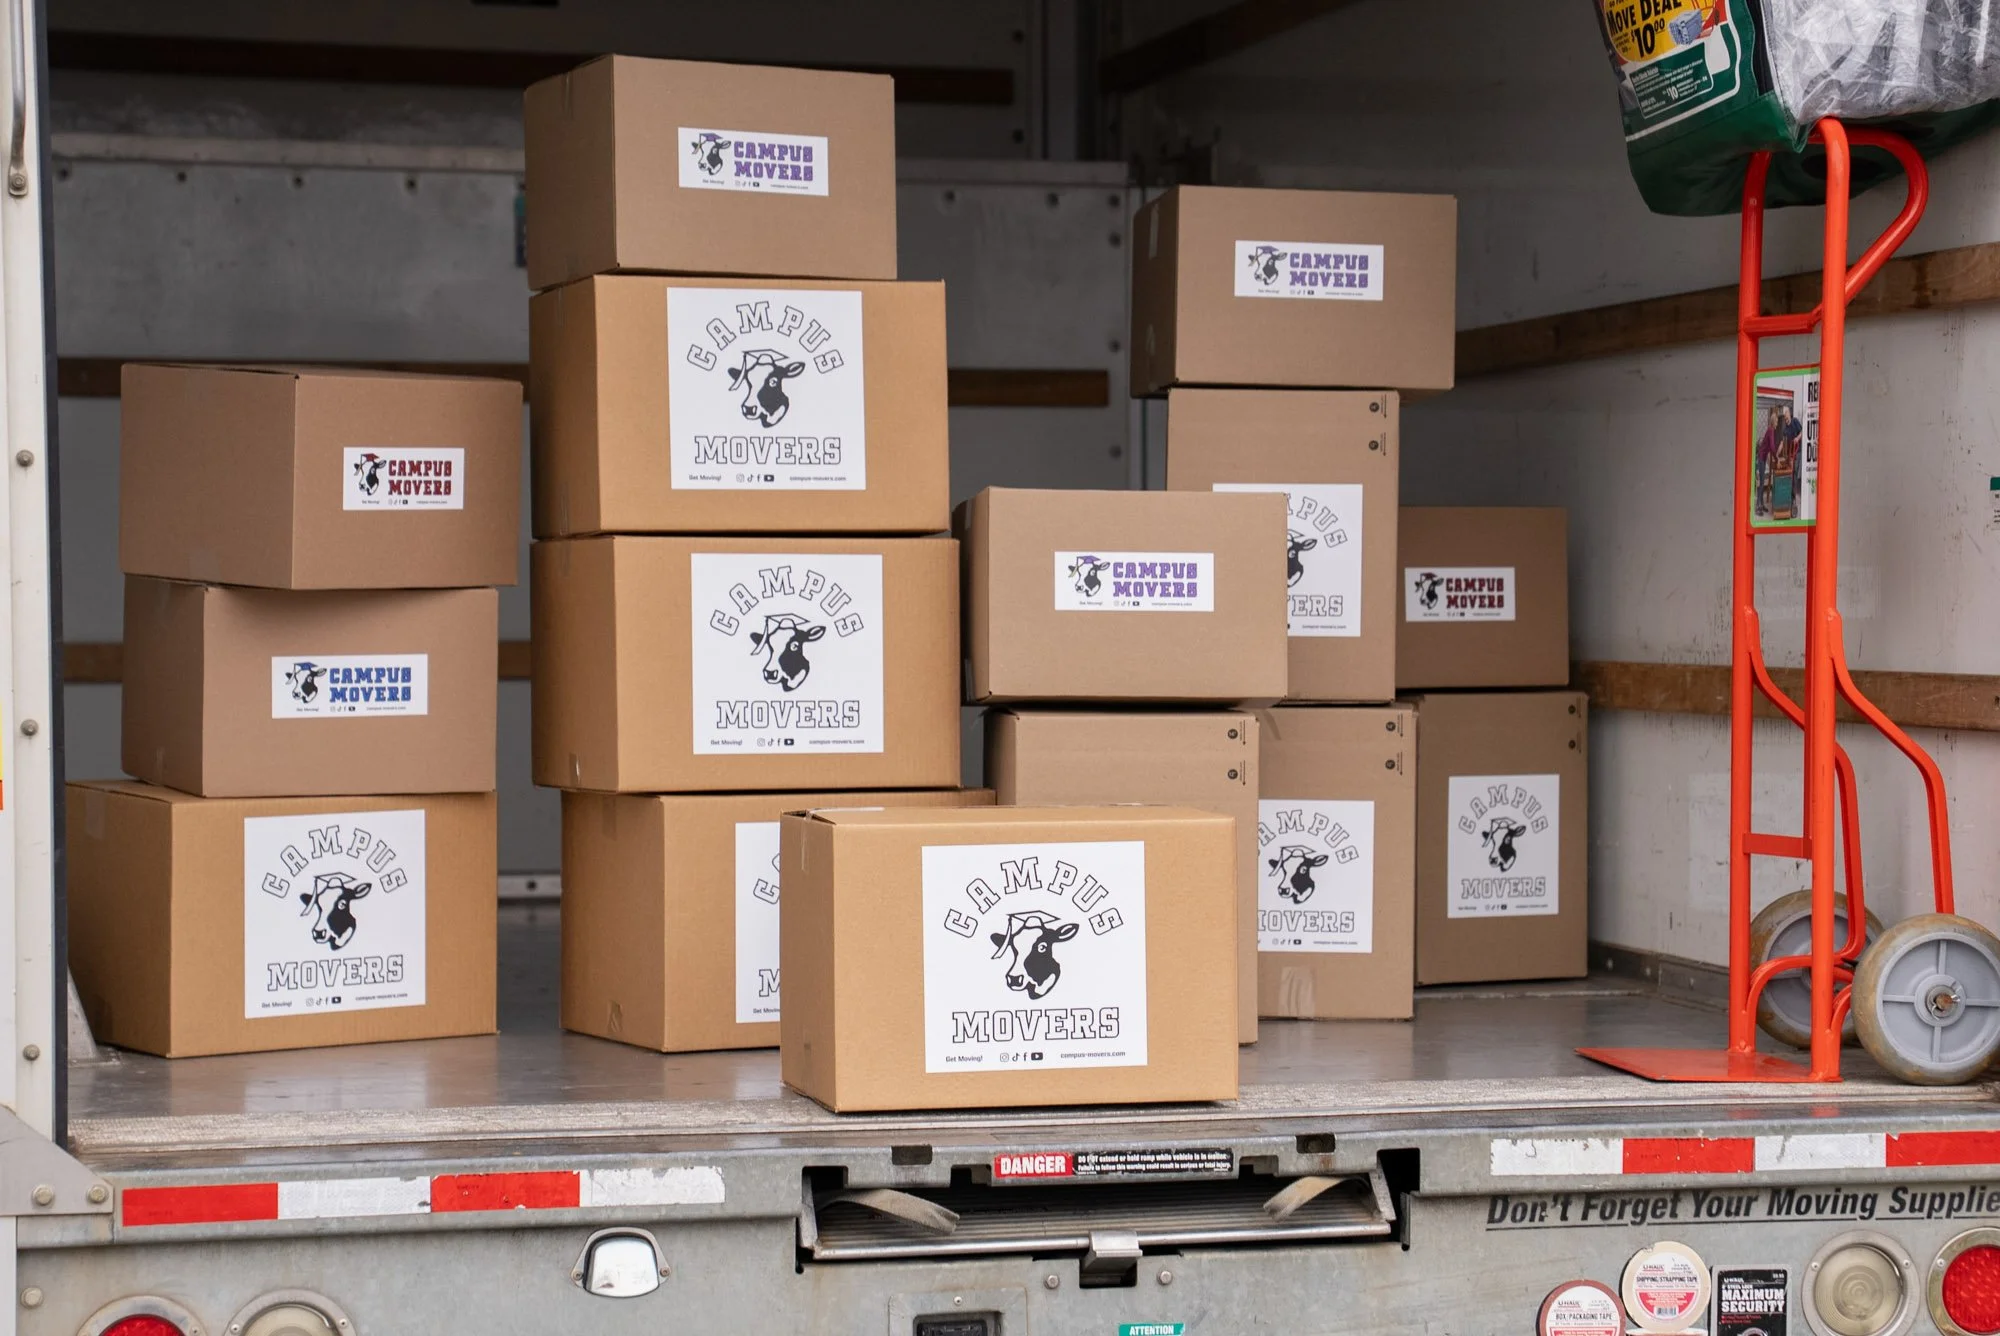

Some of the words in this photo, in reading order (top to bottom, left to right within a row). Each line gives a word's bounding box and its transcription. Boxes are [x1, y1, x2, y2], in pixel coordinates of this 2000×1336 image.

[1606, 5, 1636, 36] MOVE
[734, 141, 814, 162] CAMPUS
[734, 161, 814, 182] MOVERS
[1289, 252, 1369, 270] CAMPUS
[1289, 271, 1369, 288] MOVERS
[686, 300, 844, 374] CAMPUS
[694, 436, 842, 465] MOVERS
[388, 460, 452, 477] CAMPUS
[388, 480, 452, 496] MOVERS
[1288, 492, 1348, 548] PUS
[1112, 562, 1198, 579] CAMPUS
[1112, 582, 1198, 598] MOVERS
[1446, 578, 1504, 592] CAMPUS
[710, 565, 864, 638] CAMPUS
[1288, 595, 1343, 617] ERS
[1446, 595, 1504, 608] MOVERS
[329, 667, 412, 684] CAMPUS
[329, 686, 412, 703] MOVERS
[716, 700, 860, 729] MOVERS
[1458, 784, 1549, 835] CAMPUS
[1258, 810, 1360, 864] AMPUS
[262, 824, 408, 899] CAMPUS
[944, 856, 1124, 938] CAMPUS
[1461, 876, 1546, 899] MOVERS
[267, 954, 404, 992] MOVERS
[952, 1007, 1120, 1043] MOVERS
[958, 1055, 983, 1063] Moving!
[1000, 1156, 1066, 1175] DANGER
[1487, 1195, 1572, 1224] Don't
[1581, 1192, 1681, 1225] Forget
[1690, 1190, 1759, 1218] Your
[1767, 1188, 1879, 1220] Moving
[1889, 1186, 2000, 1219] Supplie
[1722, 1289, 1784, 1300] MAXIMUM
[1721, 1300, 1785, 1312] SECURITY
[1129, 1325, 1174, 1336] ATTENTION
